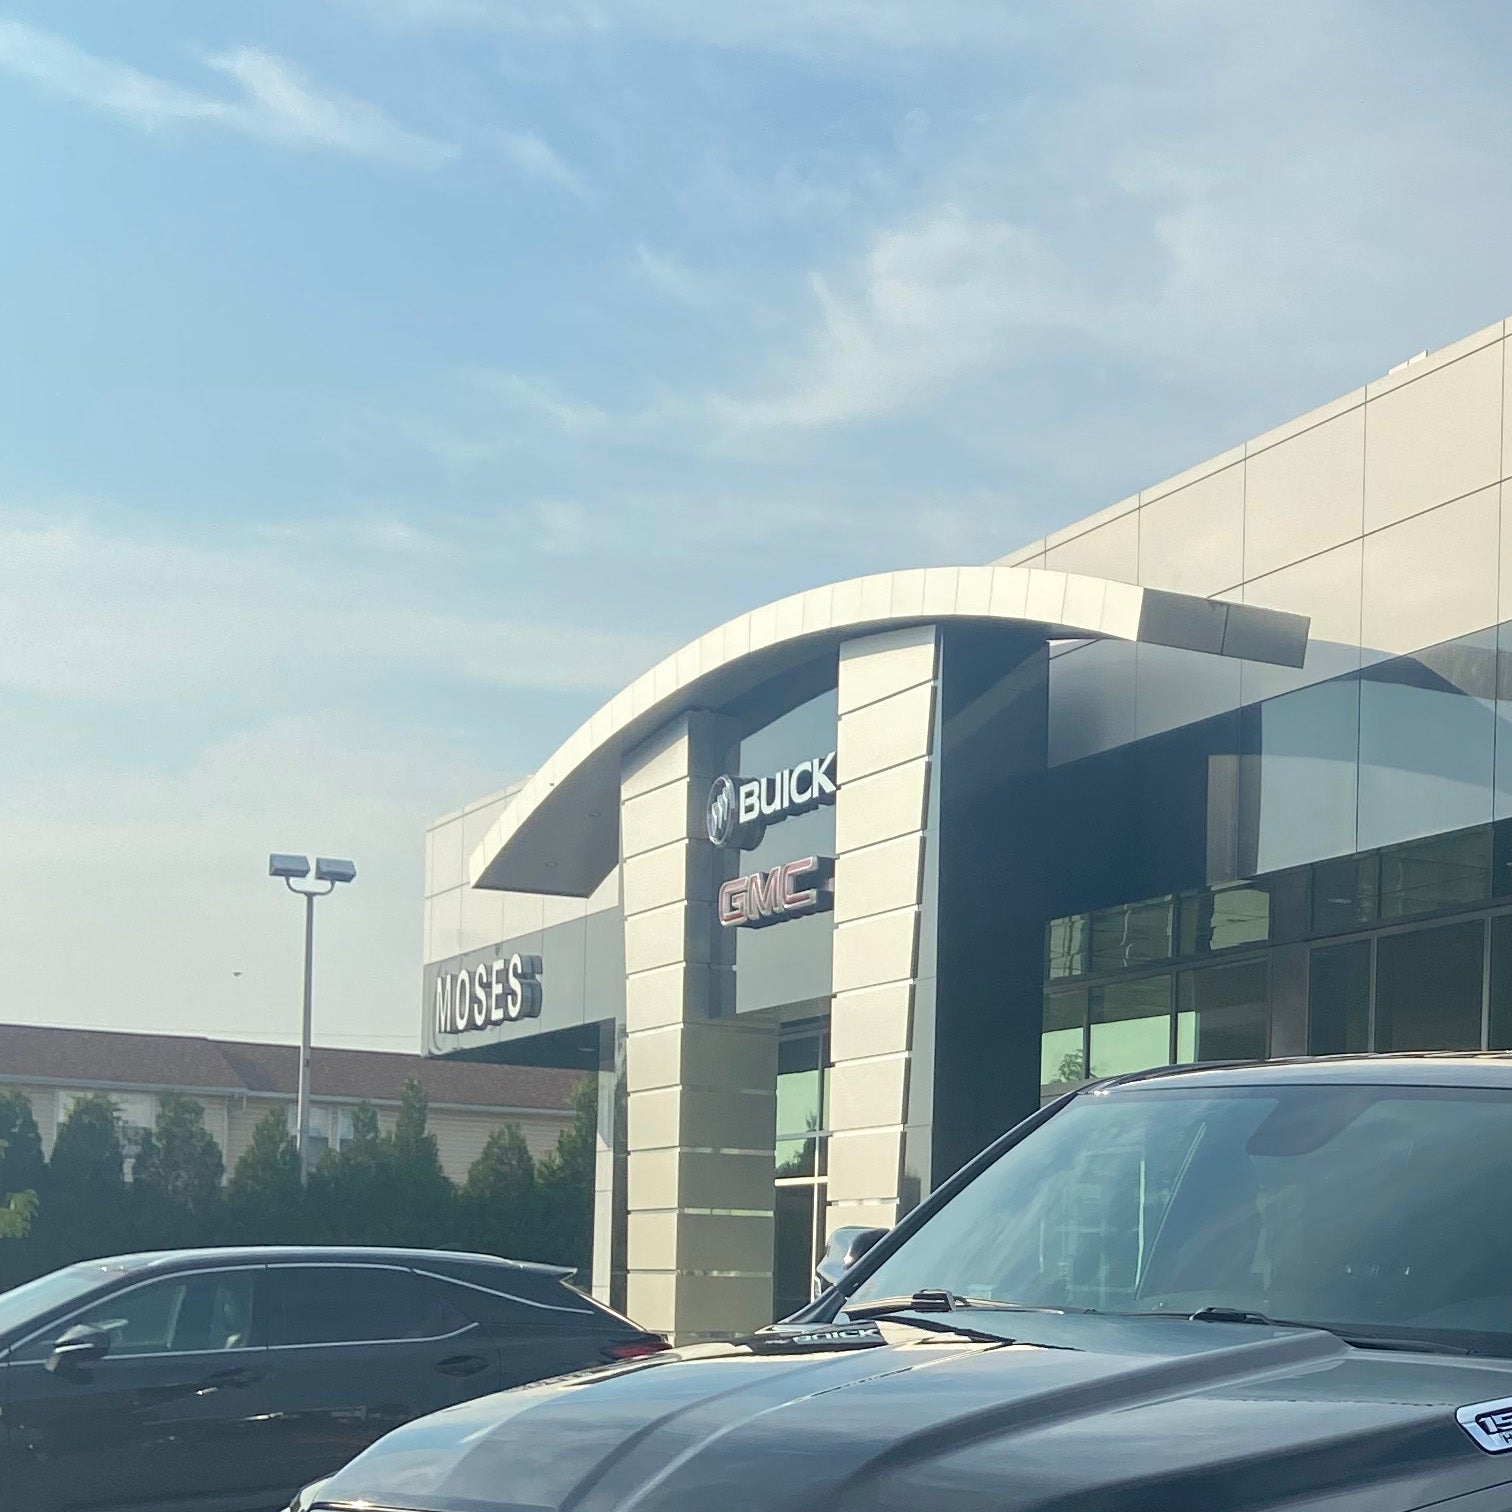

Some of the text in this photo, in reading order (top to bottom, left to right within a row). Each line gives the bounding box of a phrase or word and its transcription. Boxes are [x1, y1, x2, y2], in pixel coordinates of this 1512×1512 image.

[739, 752, 837, 823] BUICK
[718, 856, 818, 926] GMC
[435, 952, 522, 1034] MOSES
